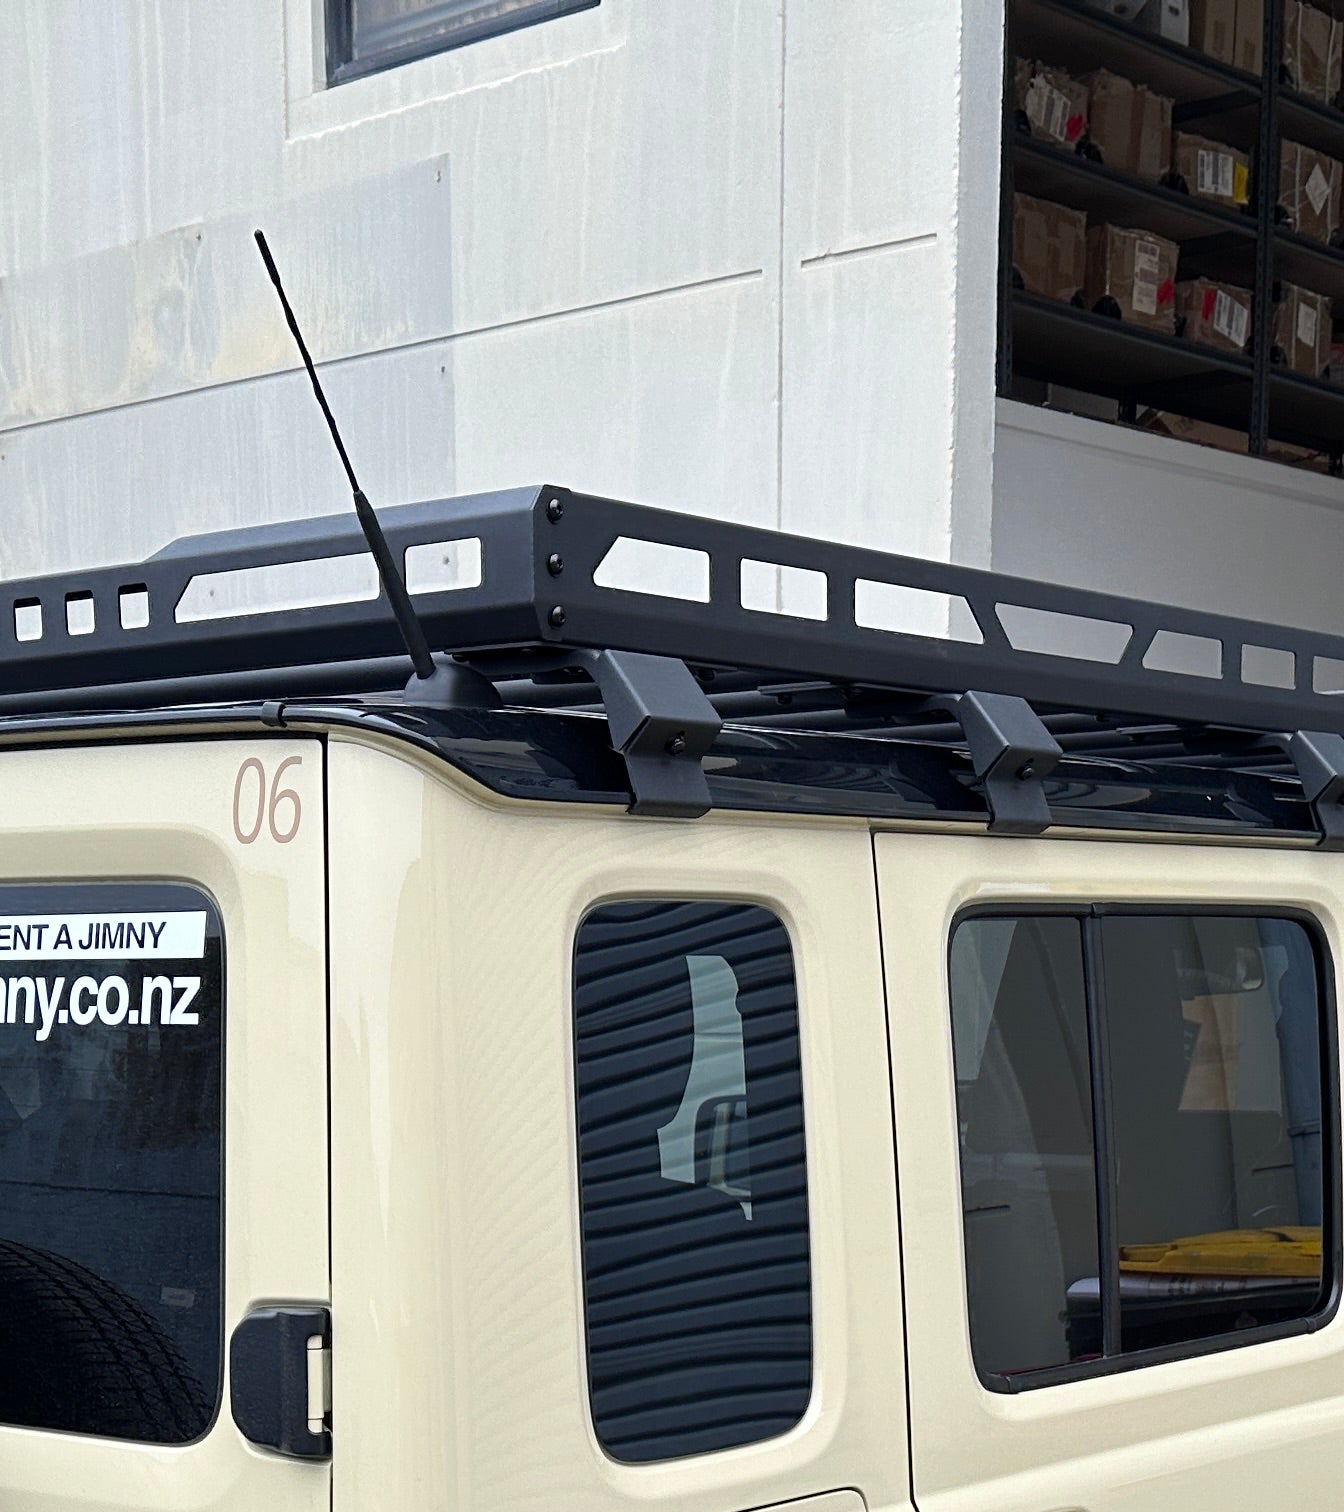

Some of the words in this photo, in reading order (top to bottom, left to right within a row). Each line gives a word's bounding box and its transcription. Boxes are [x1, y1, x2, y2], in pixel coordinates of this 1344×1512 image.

[233, 755, 303, 845] 06
[53, 922, 73, 950] A
[78, 921, 167, 950] JIMNY
